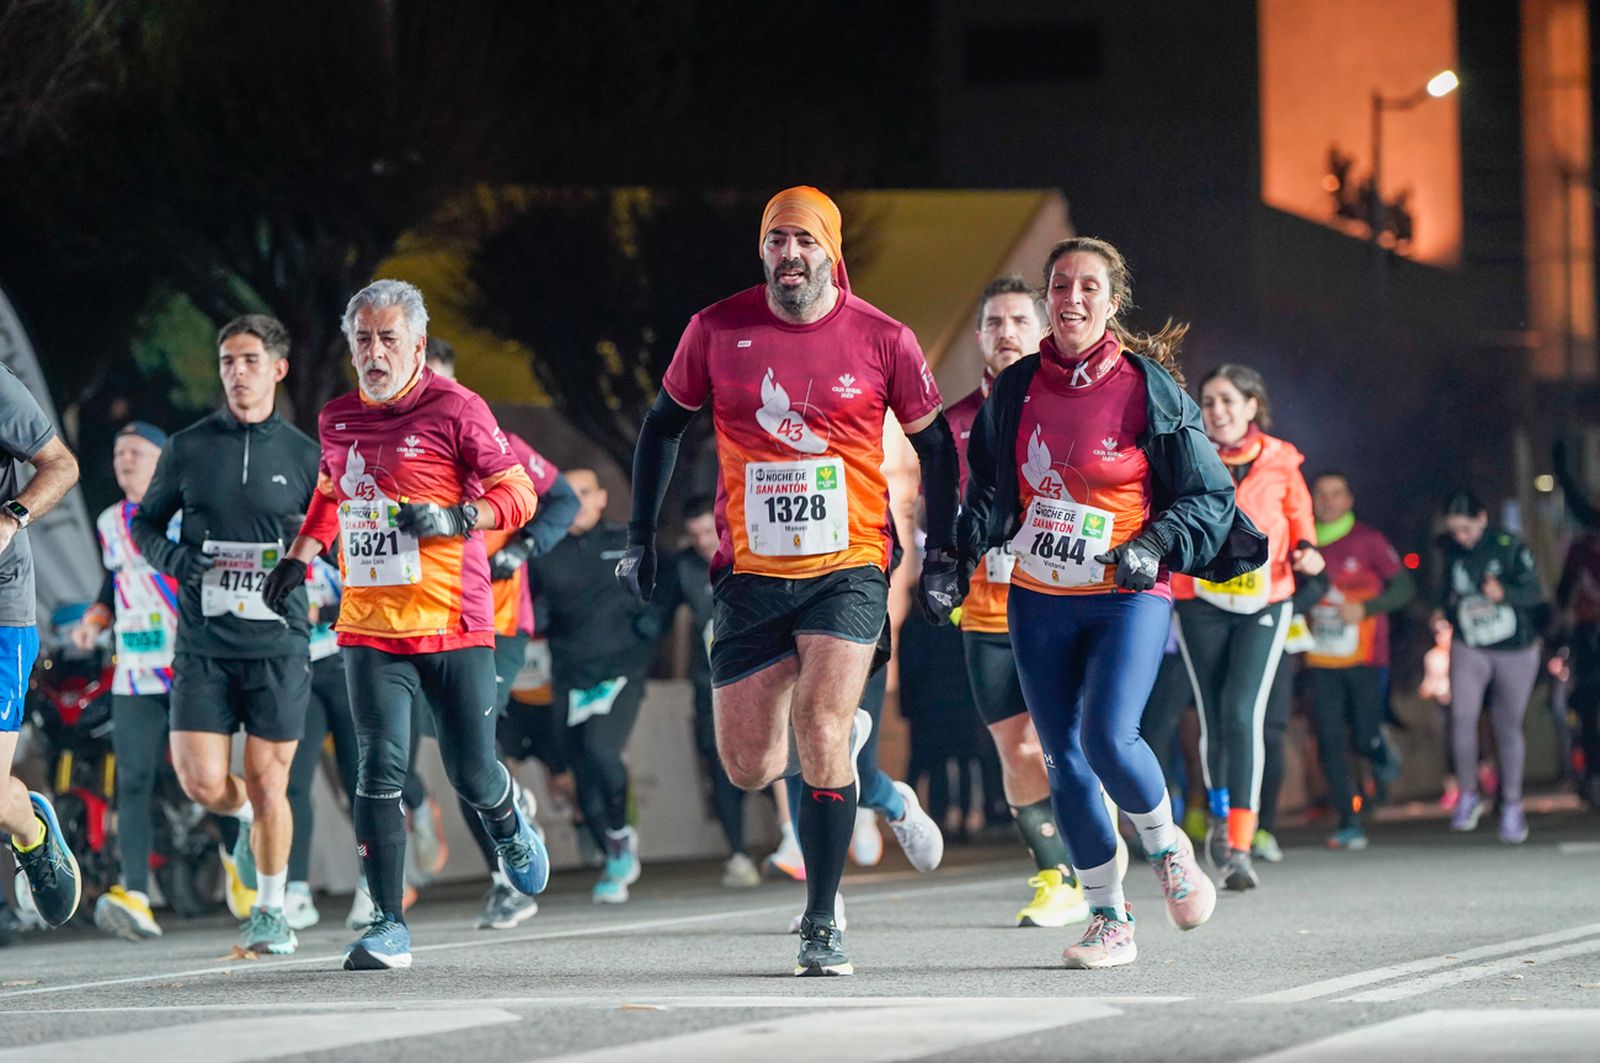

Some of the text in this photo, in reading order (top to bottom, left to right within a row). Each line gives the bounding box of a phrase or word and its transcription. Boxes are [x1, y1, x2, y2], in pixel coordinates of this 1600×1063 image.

[776, 417, 804, 442] 43
[755, 484, 774, 495] SAN
[774, 480, 808, 495] ANTÓN
[765, 472, 794, 482] NOCHE
[795, 471, 807, 482] DE
[355, 481, 376, 502] 43
[764, 494, 827, 524] 1328
[1063, 512, 1077, 523] DE
[349, 530, 399, 558] 5321
[1030, 531, 1087, 566] 1844
[220, 570, 267, 592] 4742
